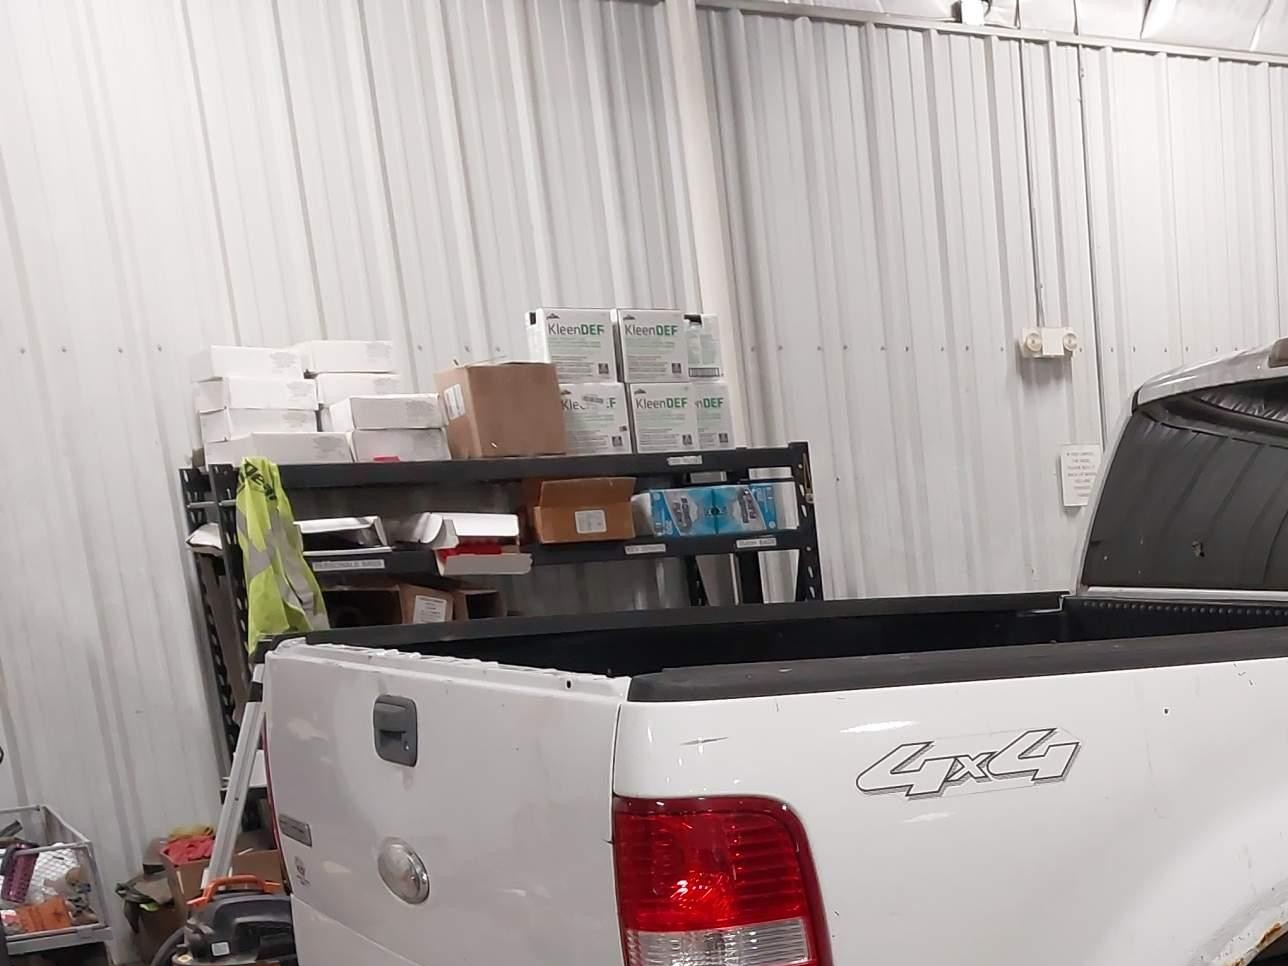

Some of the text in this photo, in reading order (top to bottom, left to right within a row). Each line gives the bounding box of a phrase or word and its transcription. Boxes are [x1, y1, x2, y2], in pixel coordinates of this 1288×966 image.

[548, 322, 605, 336] KleenDEF
[624, 323, 679, 336] KleenDEF
[635, 397, 688, 409] KleenDEF
[856, 727, 1081, 800] 4x4
